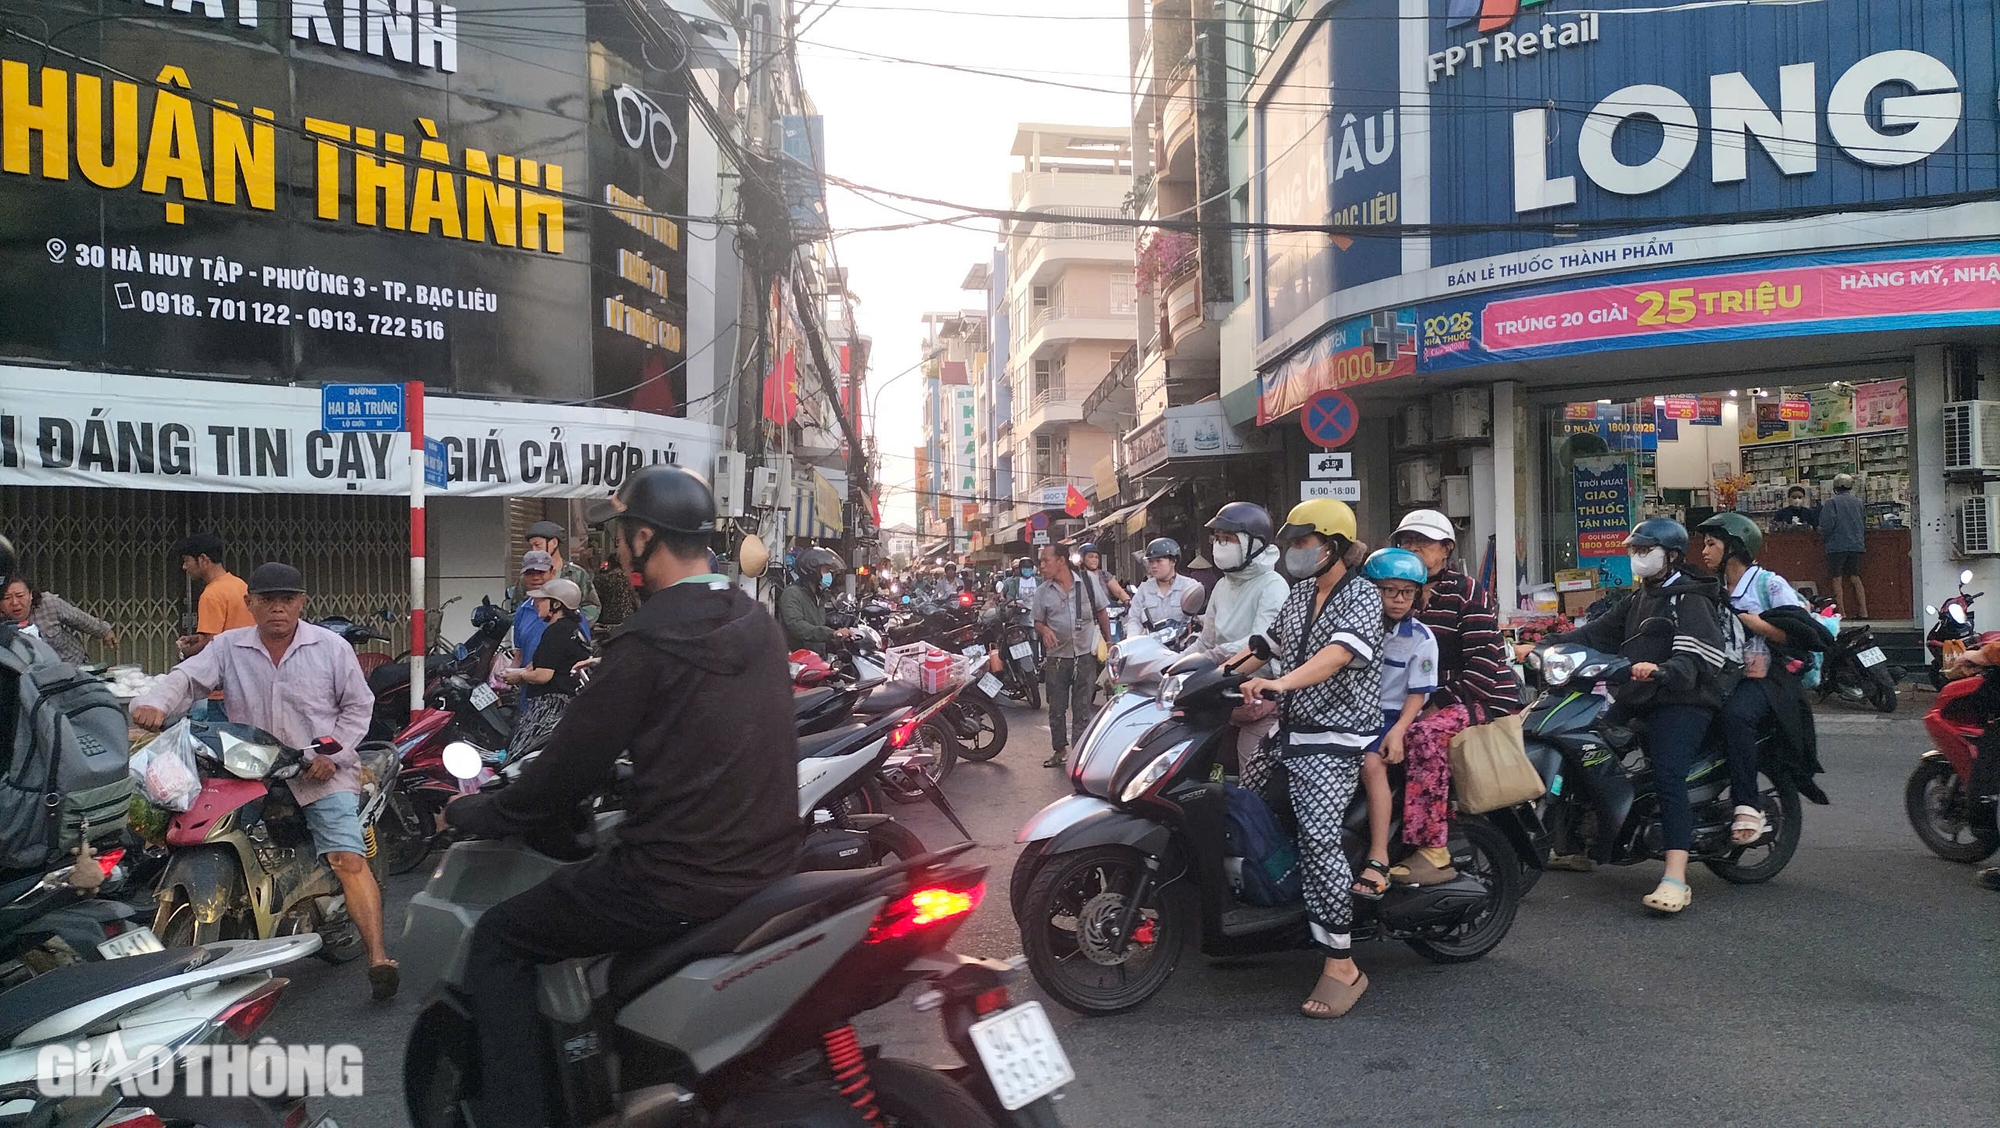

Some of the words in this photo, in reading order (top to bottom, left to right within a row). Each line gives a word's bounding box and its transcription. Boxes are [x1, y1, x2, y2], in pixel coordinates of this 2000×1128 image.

[1428, 37, 1488, 82] FPT
[1494, 13, 1599, 62] Retail
[1512, 49, 1961, 213] LONG
[304, 116, 564, 254] THÀNH
[1447, 268, 1476, 287] BÁN
[1481, 263, 1495, 281] LẺ
[1499, 254, 1553, 278] THUỐC
[1559, 248, 1616, 268] THÀNH
[1622, 236, 1674, 260] PHẨM
[75, 243, 105, 268] 30
[111, 245, 144, 272] HÀ
[149, 252, 194, 277] HUY
[200, 256, 243, 286] TẬP
[262, 265, 349, 295] PHƯỜNG
[353, 277, 366, 297] 3
[382, 280, 412, 303] TP.
[416, 285, 454, 311] BẠC
[458, 287, 498, 312] LIÊU
[1840, 267, 1904, 290] HÀNG
[1911, 264, 1948, 287] MỸ,
[141, 290, 202, 317] 0918.
[207, 297, 246, 321] 701
[252, 302, 290, 326] 122
[308, 307, 363, 333] 0913.
[368, 314, 406, 337] 722
[411, 318, 445, 340] 516
[1495, 315, 1556, 335] TRÚNG
[1560, 311, 1583, 327] 20
[1588, 303, 1627, 323] GIẢI
[1635, 287, 1697, 327] 25
[1699, 281, 1802, 315] TRIỆU
[1423, 311, 1474, 338] 2025
[1424, 336, 1441, 347] NHÀ
[1442, 331, 1472, 343] THUỐC
[348, 386, 377, 396] ĐƯỜNG
[328, 401, 345, 415] HAI
[347, 399, 362, 415] BÀ
[364, 399, 398, 415] TRƯNG
[1780, 408, 1792, 418] 25
[36, 408, 192, 475] ĐÁNG
[208, 425, 288, 478] TIN
[440, 428, 506, 483] GIÁ
[519, 426, 568, 485] CẢ
[1578, 479, 1598, 488] TRỜI
[1600, 478, 1624, 486] MƯA!
[1584, 490, 1618, 501] GIAO
[1578, 501, 1625, 516] THUỐC
[1578, 518, 1600, 530] TẬN
[1603, 517, 1627, 527] NHÀ
[1581, 541, 1602, 549] 1800
